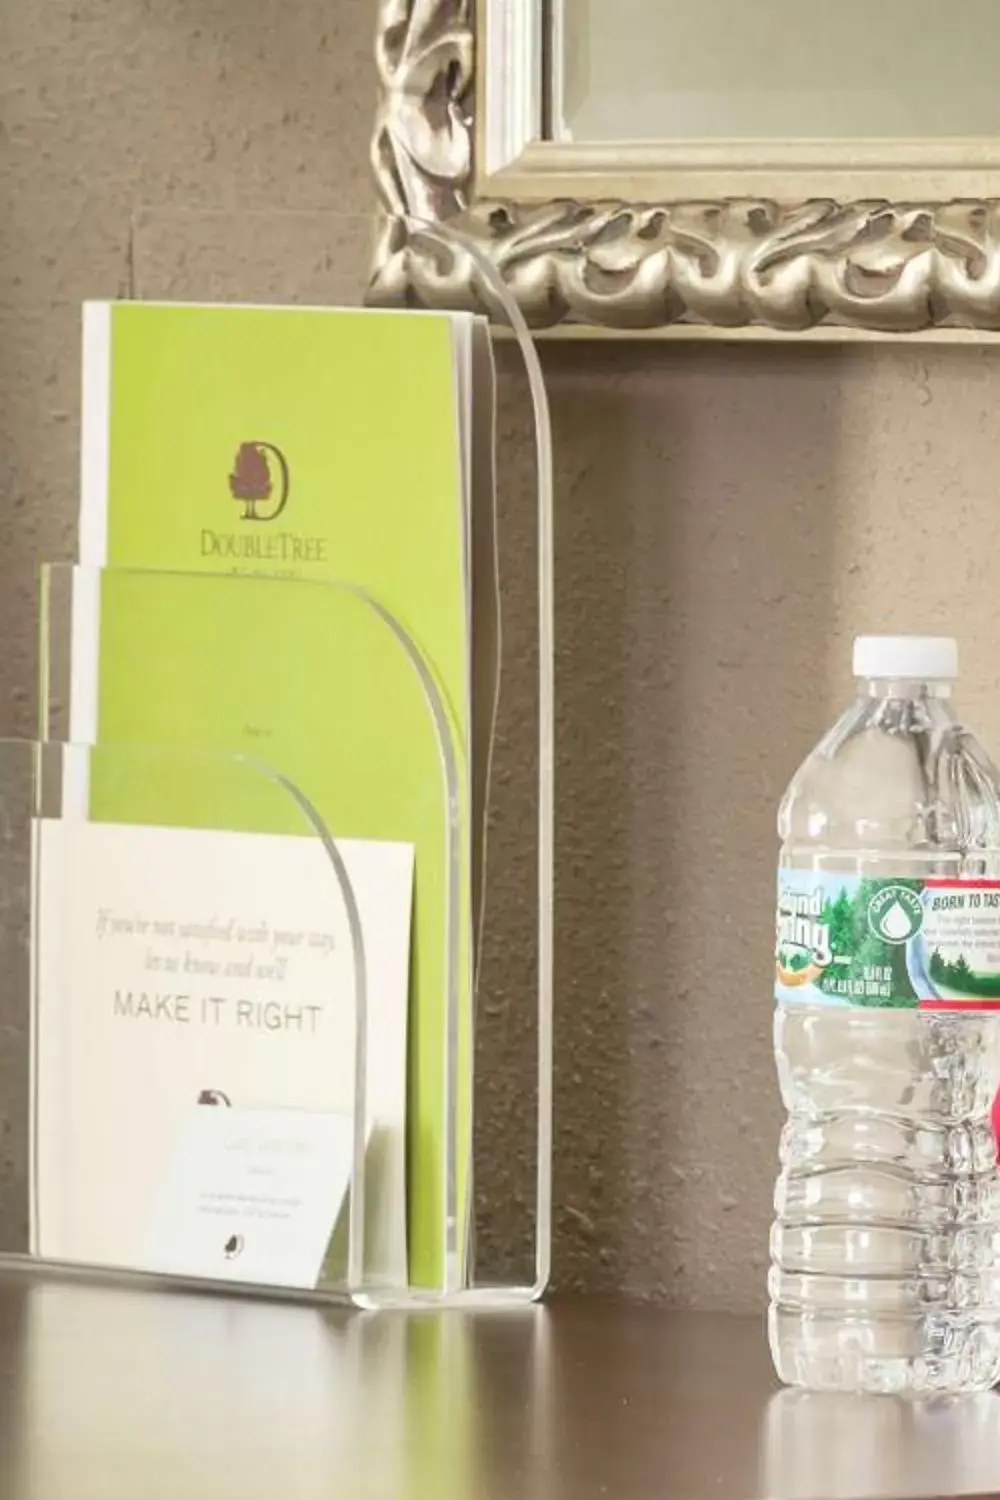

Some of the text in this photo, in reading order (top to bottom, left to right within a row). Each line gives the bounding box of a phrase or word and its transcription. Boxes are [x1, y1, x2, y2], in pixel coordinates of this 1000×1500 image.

[931, 894, 965, 912] BORN
[968, 893, 981, 909] TO
[113, 990, 323, 1033] MAKE IT RIGHT
